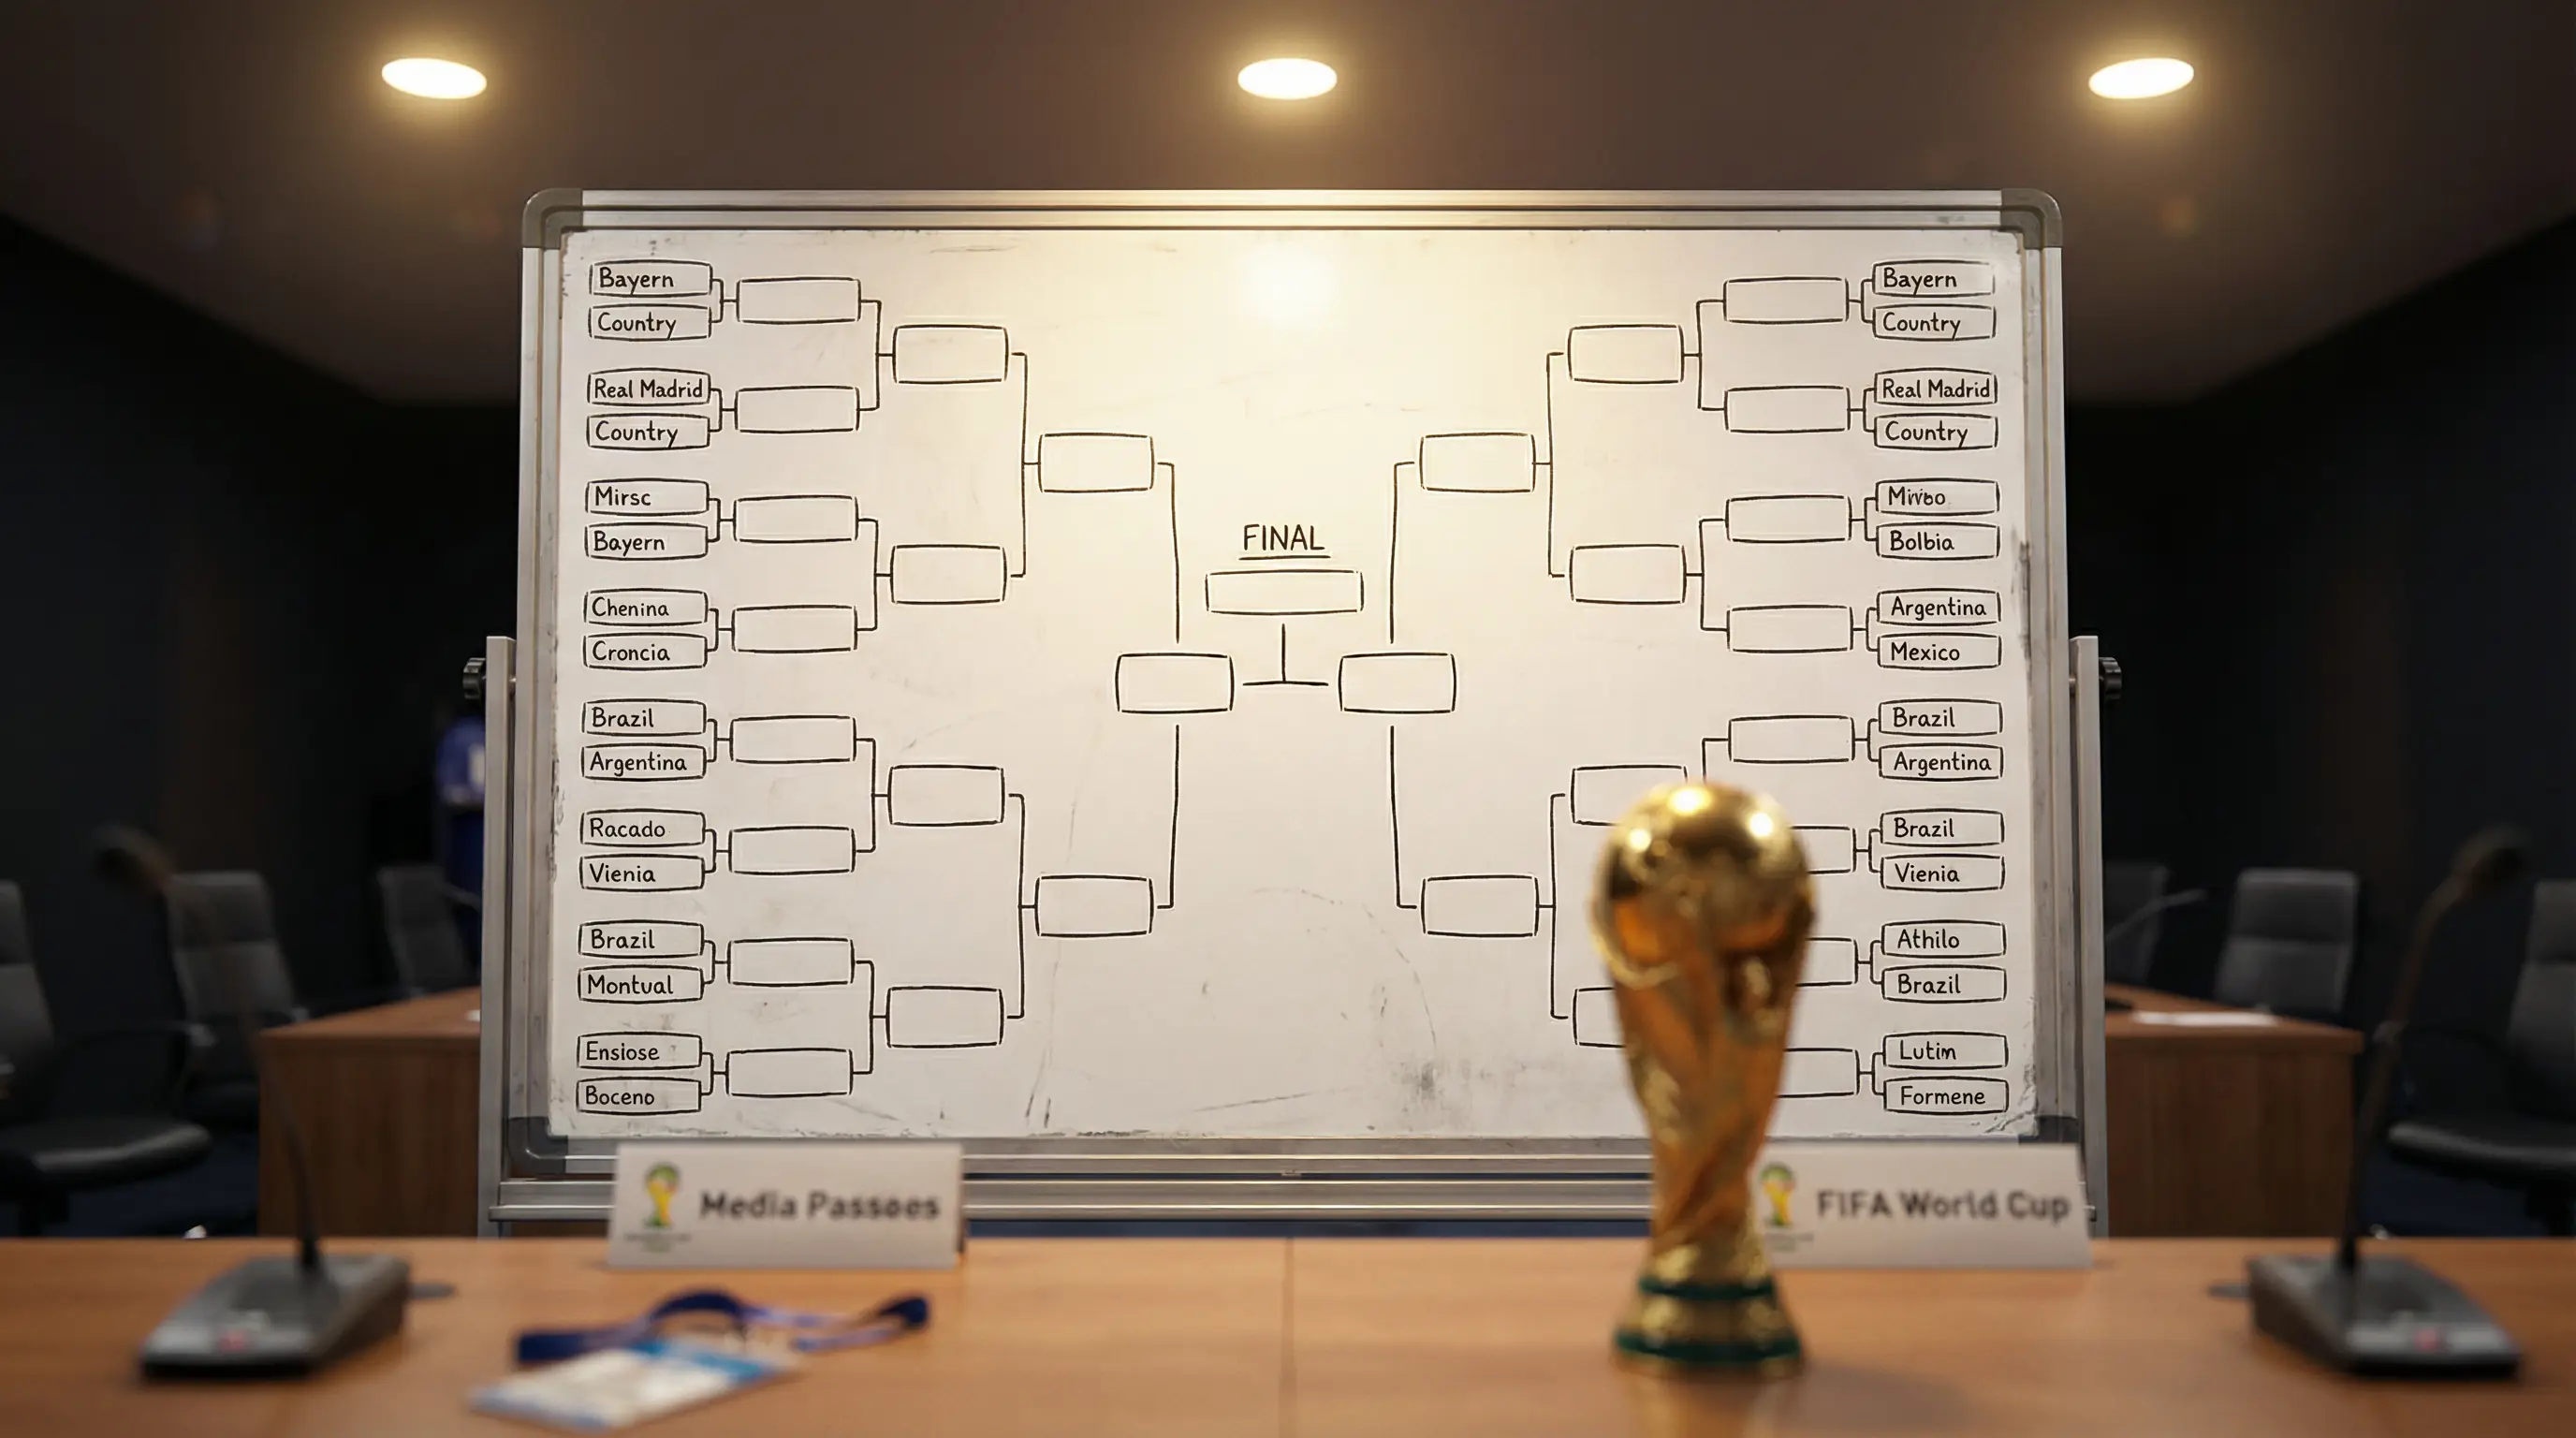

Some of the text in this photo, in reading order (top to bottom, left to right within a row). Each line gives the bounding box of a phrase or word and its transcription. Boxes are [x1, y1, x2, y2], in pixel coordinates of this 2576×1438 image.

[599, 266, 675, 295] Bayern
[1883, 266, 1957, 295] Bayern
[597, 311, 677, 340] Country
[1882, 311, 1961, 340] Country
[594, 377, 703, 399] Real Madrid
[1882, 377, 1990, 399] Real Madrid
[595, 419, 679, 448] Country
[1884, 419, 1969, 448] Country
[594, 485, 651, 506] Mirsc
[593, 529, 666, 557] Bayern
[1243, 523, 1325, 550] FINAL
[1889, 529, 1955, 551] Bolbia
[592, 595, 670, 617] Chenina
[1890, 595, 1987, 622] Argentina
[592, 639, 671, 662] Croncia
[1891, 640, 1961, 662] Mexico
[591, 706, 654, 728] Brazil
[1892, 706, 1955, 728] Brazil
[589, 750, 688, 778] Argentina
[1893, 751, 1993, 778] Argentina
[589, 816, 666, 838] Racado
[1893, 816, 1955, 839] Brazil
[589, 862, 657, 884] Vienia
[1894, 861, 1961, 883] Vienia
[591, 928, 656, 949] Brazil
[1896, 928, 1960, 949] Athilo
[1897, 973, 1962, 995] Brazil
[586, 1040, 660, 1062] Ensiose
[585, 1084, 655, 1106] Boceno
[1900, 1085, 1986, 1106] Formene
[699, 1189, 797, 1220] Media
[1816, 1189, 2071, 1226] FIFA World Cup
